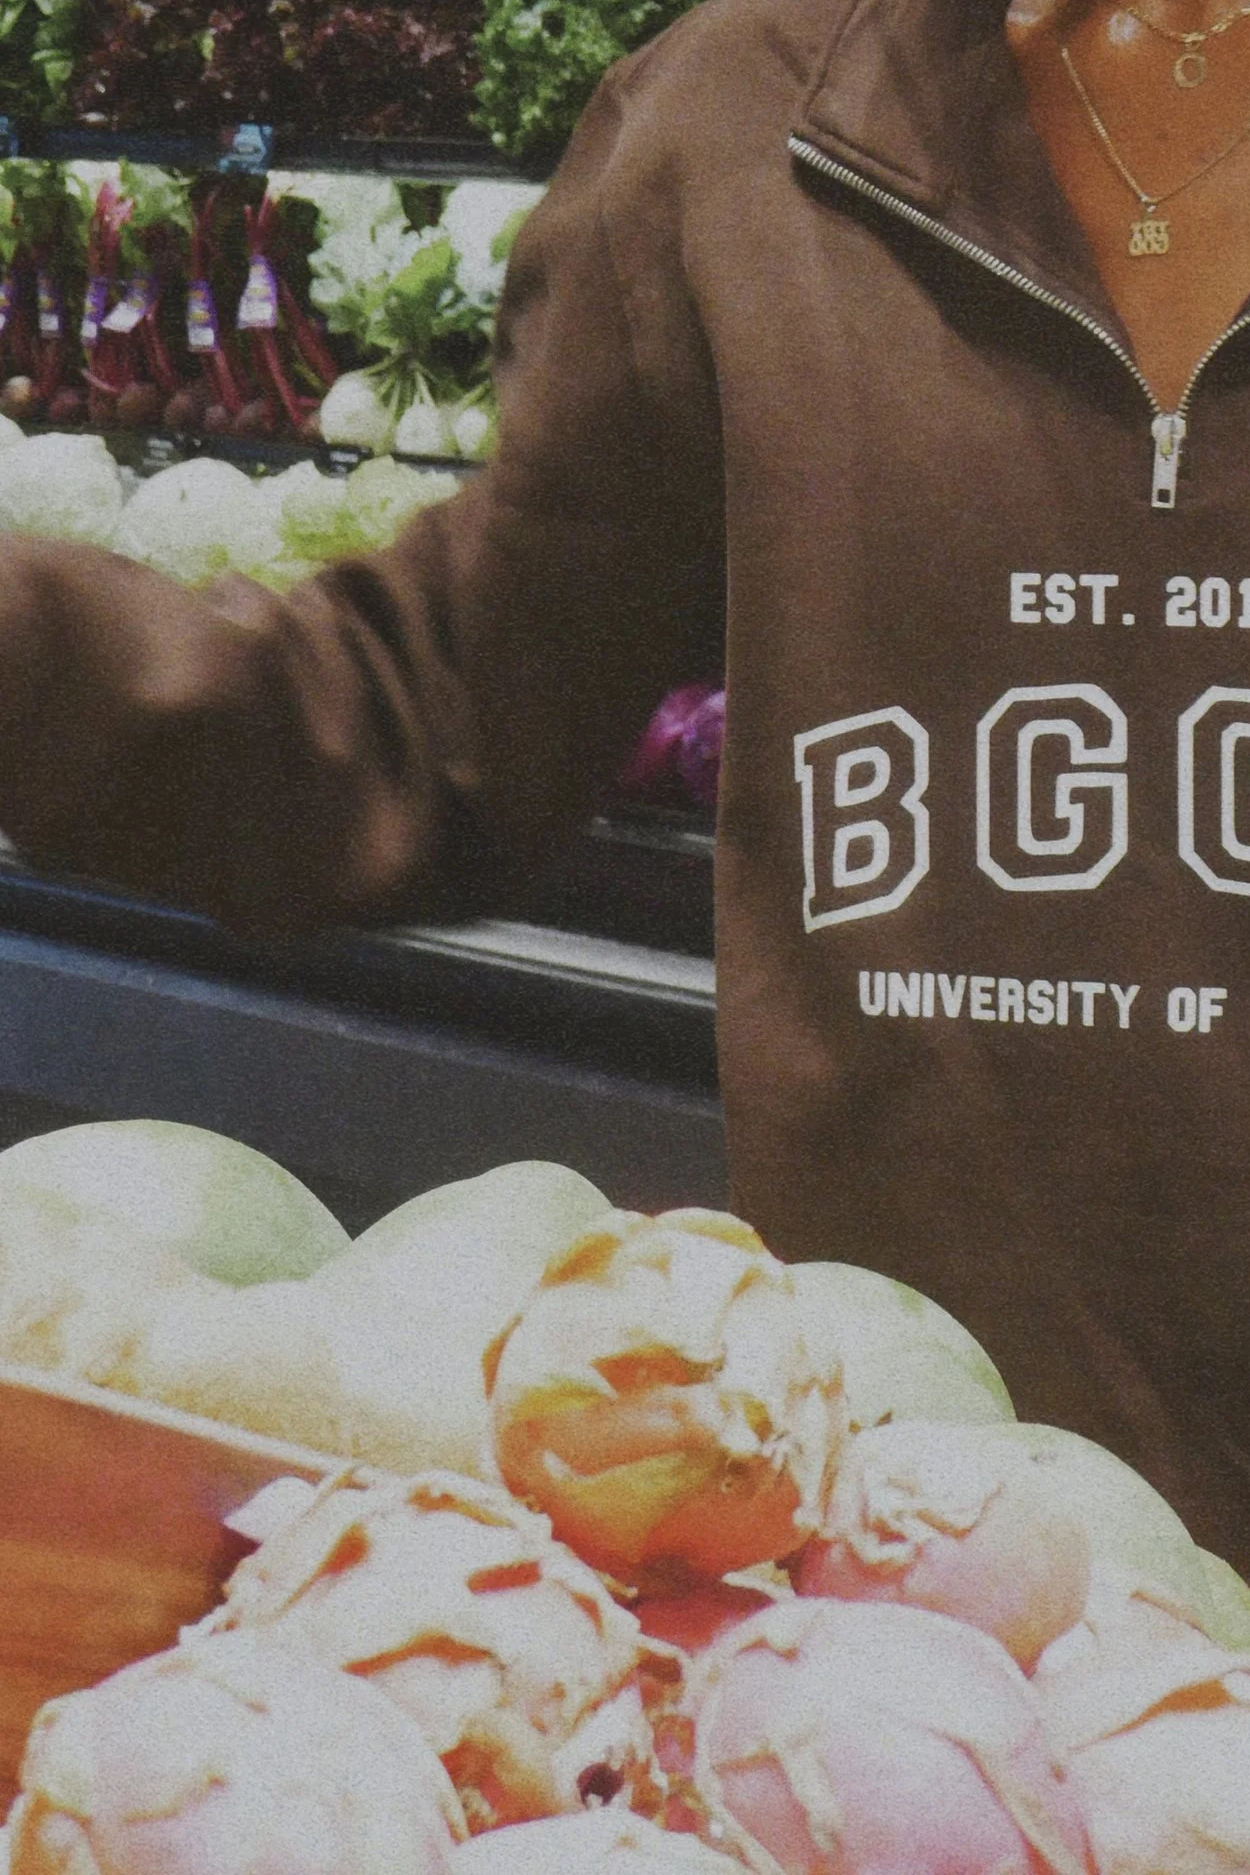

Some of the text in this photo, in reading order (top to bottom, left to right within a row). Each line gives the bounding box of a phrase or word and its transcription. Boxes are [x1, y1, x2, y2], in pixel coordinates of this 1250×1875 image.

[1010, 572, 1135, 625] EST.
[859, 970, 1141, 1029] UNIVERSITY
[1167, 987, 1228, 1033] OF
